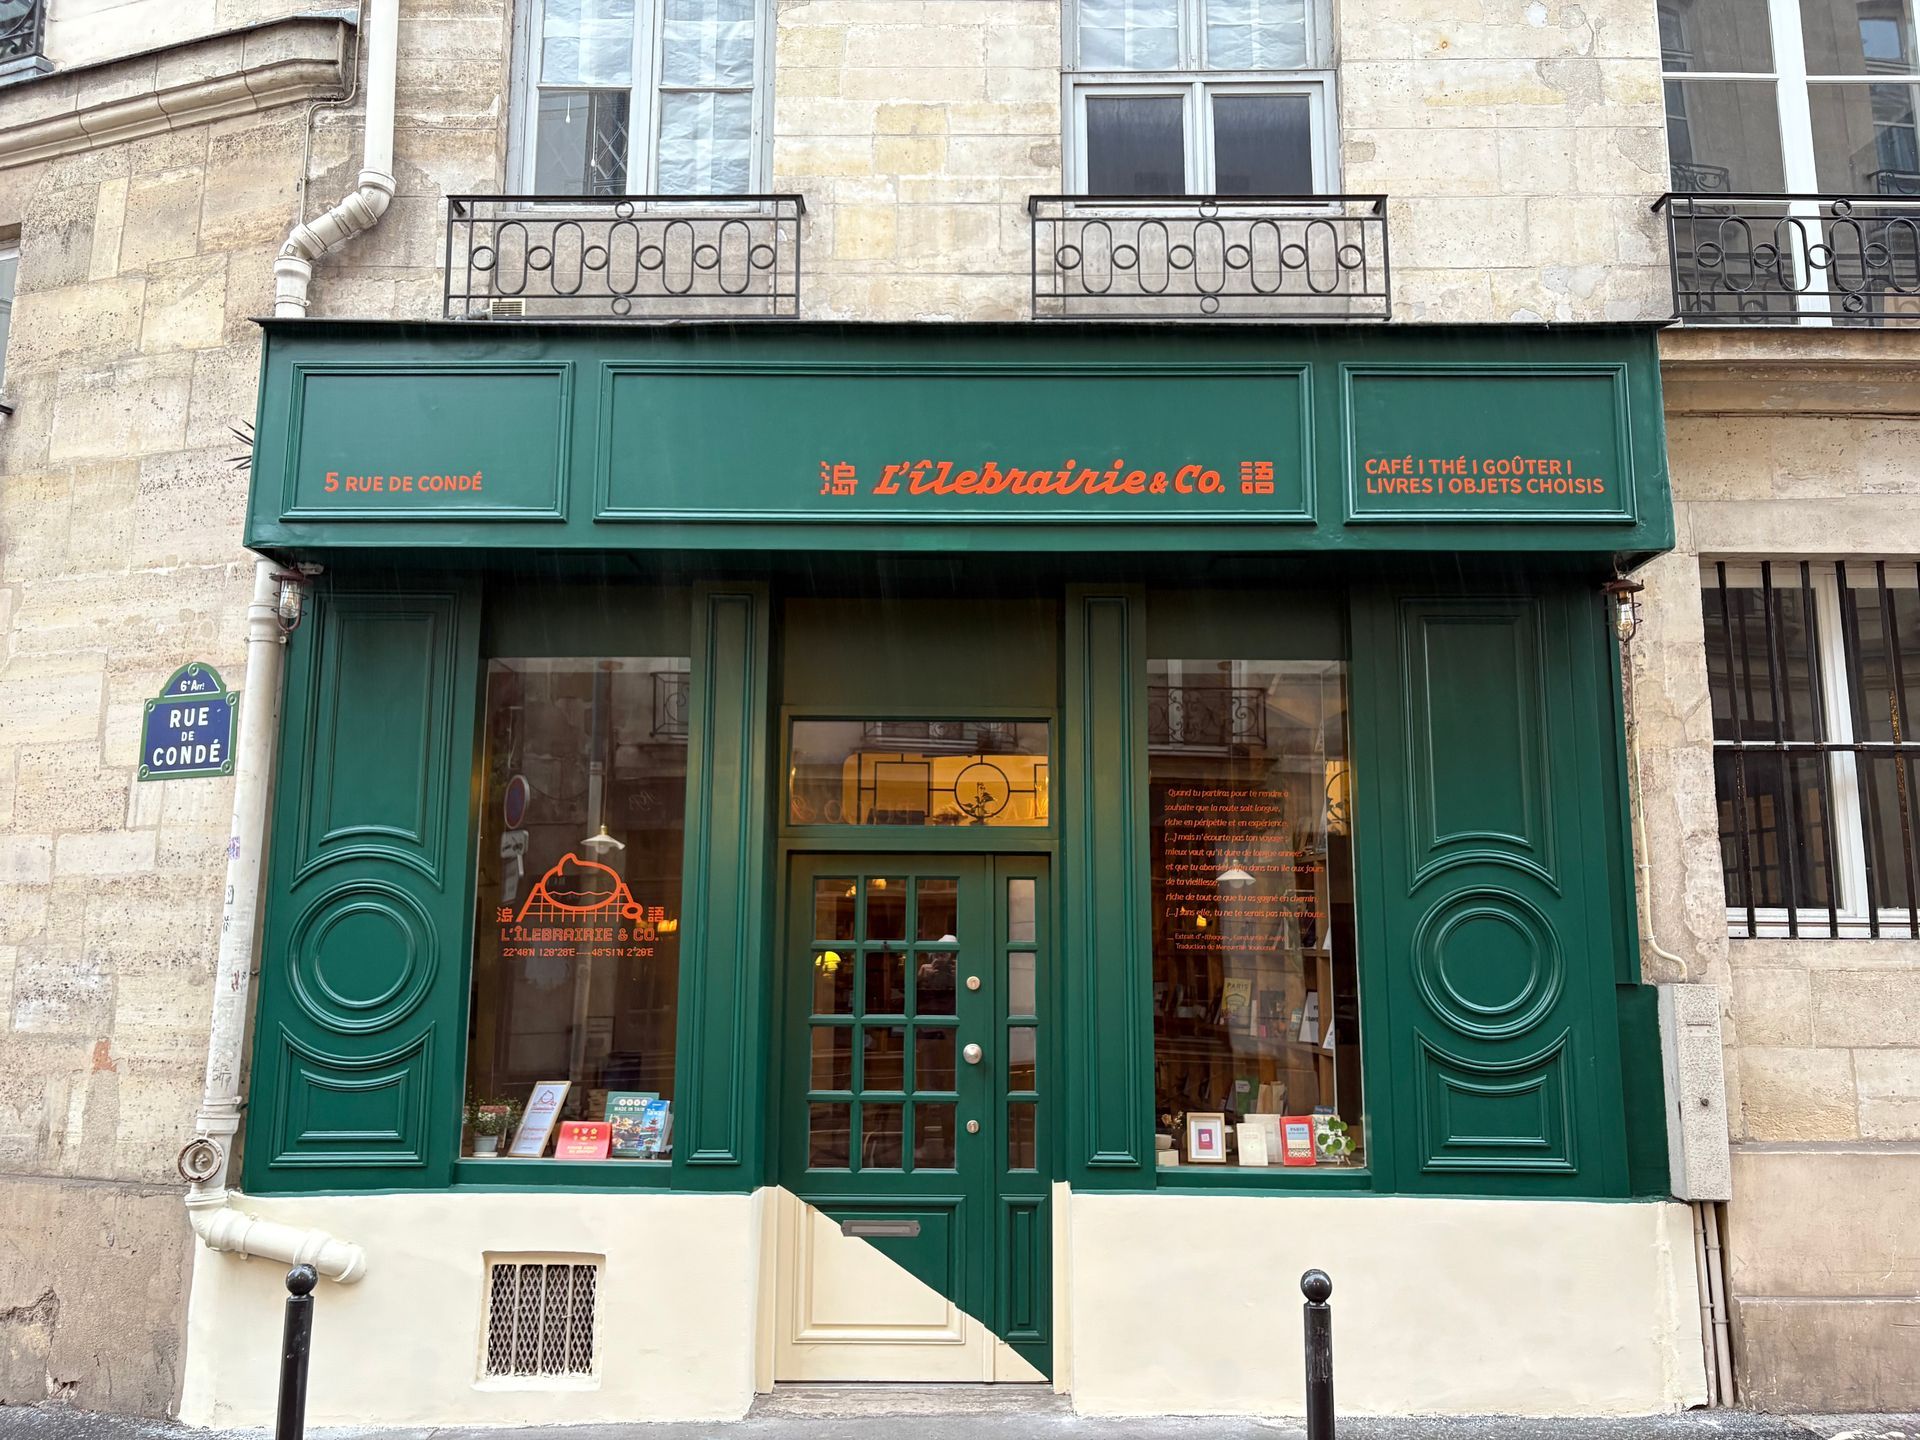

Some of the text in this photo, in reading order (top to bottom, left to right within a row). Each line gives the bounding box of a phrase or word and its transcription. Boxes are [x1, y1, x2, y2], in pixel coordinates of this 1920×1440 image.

[1364, 455, 1413, 475] CAFÉ
[1428, 456, 1468, 475] THÉ
[1482, 456, 1563, 476] GOÛTER
[324, 471, 482, 492] 5 RUE DE CONDÉ
[1149, 473, 1168, 494] &
[1174, 465, 1226, 494] Co.
[1240, 461, 1275, 494] 語
[1366, 478, 1433, 494] LIVRES
[1448, 478, 1523, 494] OBJETS
[1526, 478, 1605, 494] CHOISIS
[169, 706, 210, 729] RUE
[181, 731, 195, 742] DE
[152, 738, 221, 767] CONDÉ
[1168, 788, 1192, 798] Quand
[1201, 789, 1230, 798] partiras
[1230, 790, 1248, 798] pour
[1249, 790, 1258, 798] te
[1164, 803, 1195, 812] souhaite
[1195, 805, 1210, 813] que
[1210, 803, 1218, 812] la
[1218, 804, 1239, 812] route
[1239, 804, 1254, 812] soit
[1164, 818, 1183, 826] riche
[1177, 833, 1196, 841] mais
[1231, 834, 1245, 843] pas
[1245, 834, 1258, 842] ton
[1165, 848, 1188, 856] mieux
[1188, 848, 1205, 857] vaut
[1241, 848, 1252, 857] de
[1165, 862, 1174, 871] et
[1174, 863, 1190, 872] que
[1190, 863, 1199, 871] tu
[1248, 862, 1266, 872] dans
[1266, 863, 1280, 872] ton
[1290, 864, 1305, 873] aux
[1165, 878, 1176, 886] de
[1165, 892, 1184, 902] riche
[1185, 892, 1196, 901] de
[1196, 893, 1212, 902] tout
[1212, 894, 1222, 902] ce
[1222, 894, 1238, 903] que
[1238, 894, 1248, 902] tu
[1279, 895, 1290, 903] en
[1214, 909, 1223, 917] tu
[1234, 910, 1243, 918] te
[1265, 911, 1279, 919] pas
[617, 927, 629, 942] &
[632, 927, 661, 942] CO.
[1175, 942, 1206, 951] Traduction
